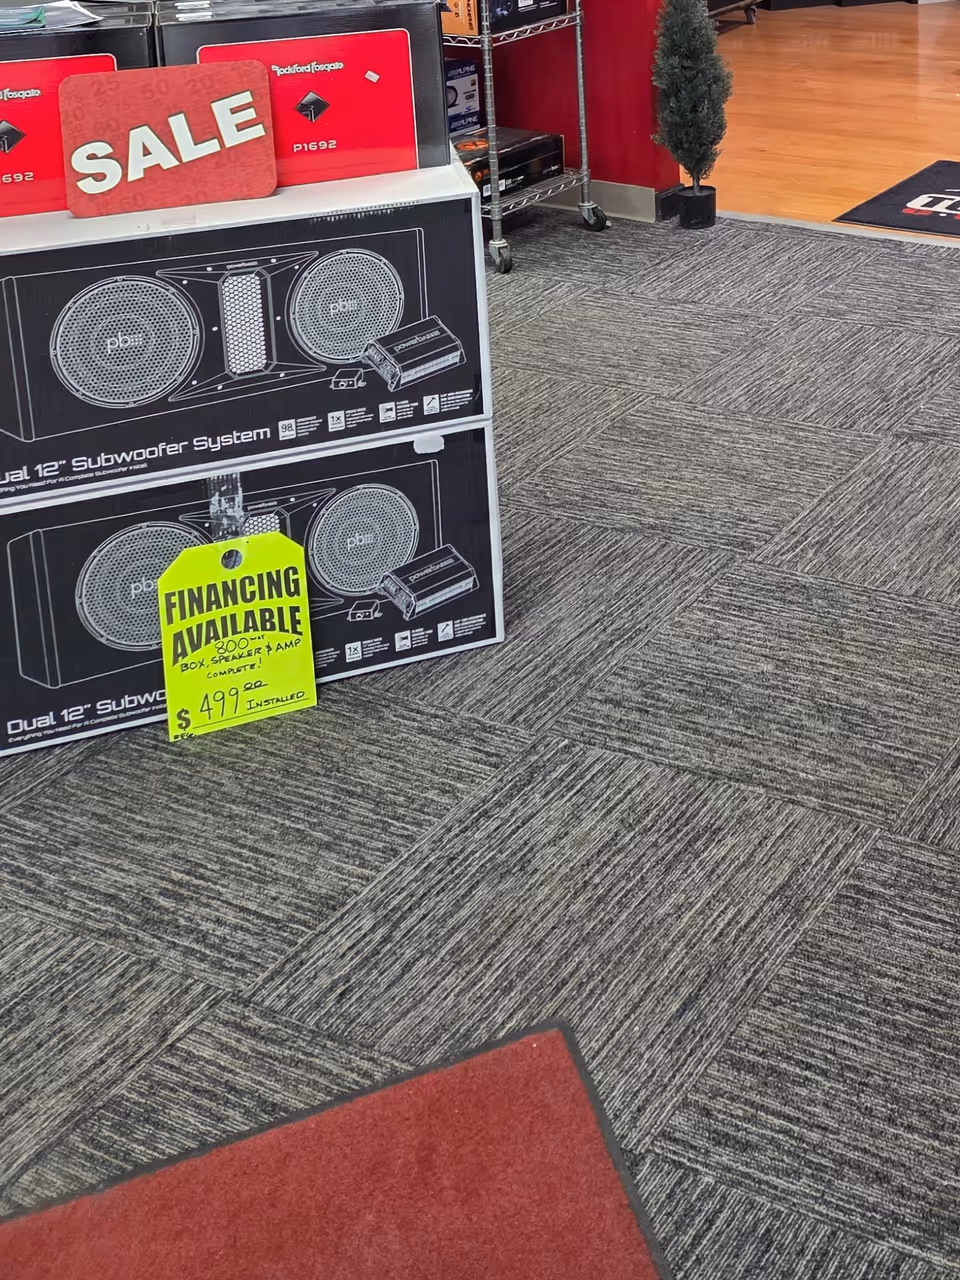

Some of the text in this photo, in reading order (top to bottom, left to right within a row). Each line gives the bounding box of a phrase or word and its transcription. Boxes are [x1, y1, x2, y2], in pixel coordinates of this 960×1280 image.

[71, 89, 266, 195] SALE
[293, 140, 337, 153] P1692
[1, 172, 34, 183] 692
[0, 465, 30, 484] ual
[71, 440, 188, 472] Subwoofer
[193, 426, 271, 452] System
[164, 565, 300, 626] FINANCING
[171, 605, 303, 667] AVAILABLE
[215, 637, 249, 655] 800
[211, 647, 262, 666] SPEAKER
[275, 638, 302, 652] AMP
[7, 711, 57, 735] Dual
[96, 689, 168, 715] Subwo
[200, 687, 240, 721] 499
[246, 690, 306, 711] INSTALLED
[176, 707, 192, 732] $
